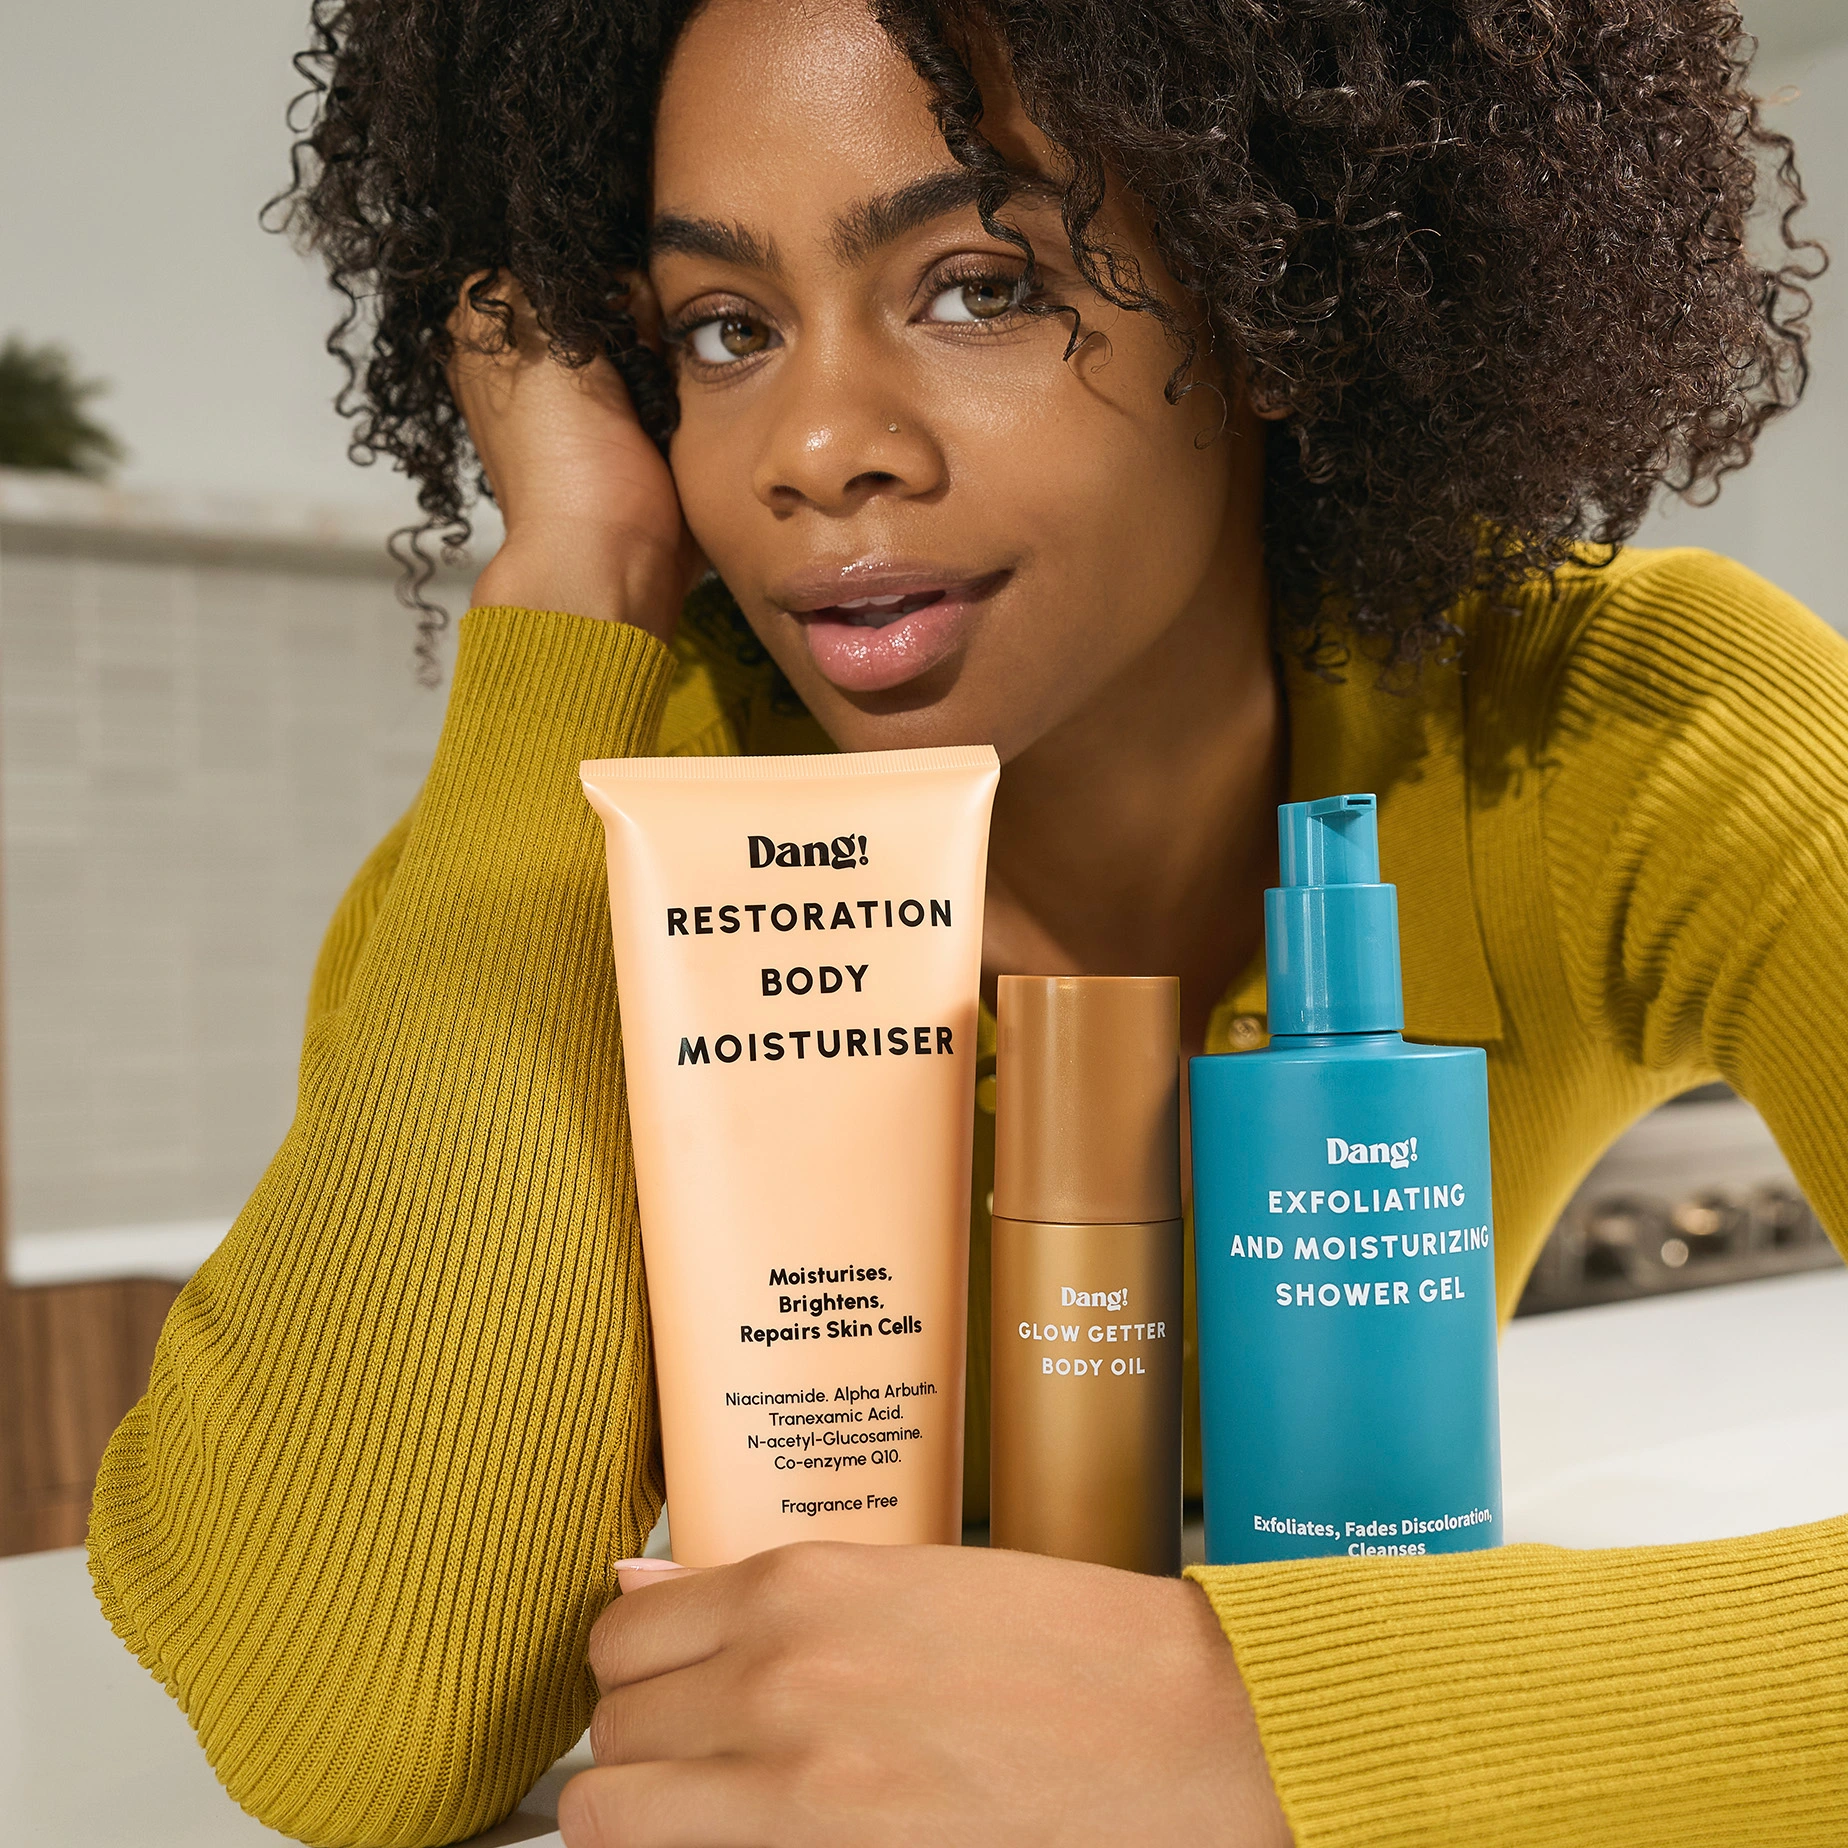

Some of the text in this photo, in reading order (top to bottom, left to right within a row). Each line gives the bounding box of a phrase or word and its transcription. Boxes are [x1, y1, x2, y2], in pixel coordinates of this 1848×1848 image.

[747, 833, 869, 870] Dang!
[667, 899, 953, 936] RESTORATION
[761, 964, 869, 997] BODY
[677, 1026, 954, 1066] MOISTURISER
[1326, 1137, 1417, 1169] Dang!
[1268, 1183, 1465, 1214] EXFOLIATING
[1230, 1225, 1489, 1260] AND MOISTURIZING
[769, 1264, 893, 1286] Moisturises,
[779, 1292, 884, 1317] Brightens,
[1061, 1286, 1128, 1312] Dang!
[1276, 1276, 1465, 1307] SHOWER GEL
[740, 1315, 922, 1347] Repairs Skin Cells
[1018, 1321, 1166, 1342] GLOW GETTER
[1042, 1357, 1146, 1376] BODY OIL
[725, 1381, 938, 1406] Niacinamide. Alpha Arbutin.
[769, 1405, 904, 1426] Tranexamic Acid.
[747, 1427, 923, 1451] N-acetyl-Glucosamine.
[774, 1448, 902, 1471] Co-enzyme Q10.
[781, 1494, 898, 1516] Fragrance Free
[1254, 1507, 1492, 1540] Exfoliates, Fades Discoloration,
[1348, 1541, 1426, 1557] Cleanses
